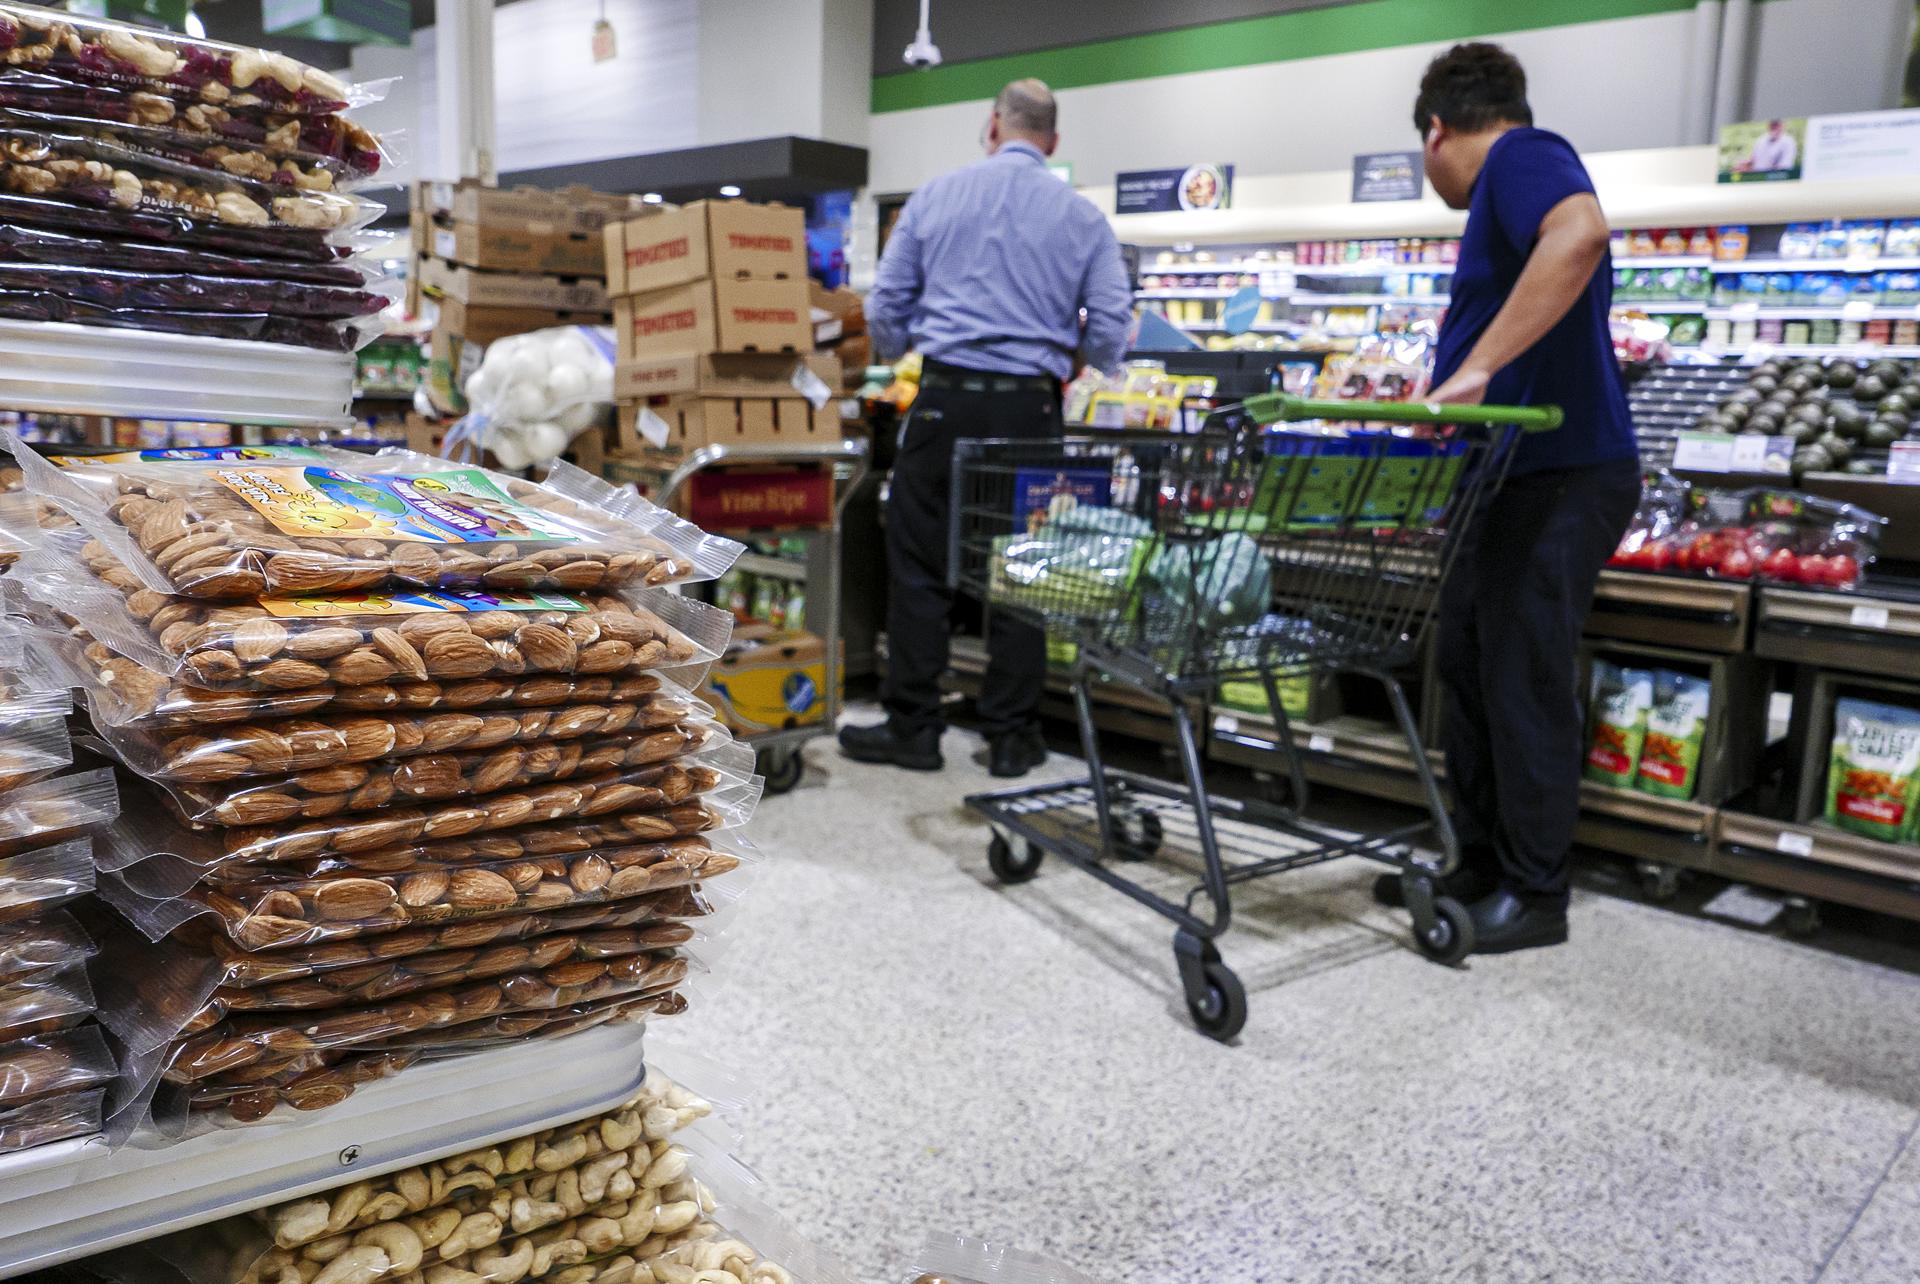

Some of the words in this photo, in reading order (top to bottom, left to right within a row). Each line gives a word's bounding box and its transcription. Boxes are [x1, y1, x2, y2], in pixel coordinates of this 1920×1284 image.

[625, 236, 689, 269] TOMATOES
[728, 233, 793, 252] TOMATOES
[634, 308, 697, 337] TOMATOES
[733, 307, 799, 324] TOMATOES
[412, 500, 483, 531] NATURAL
